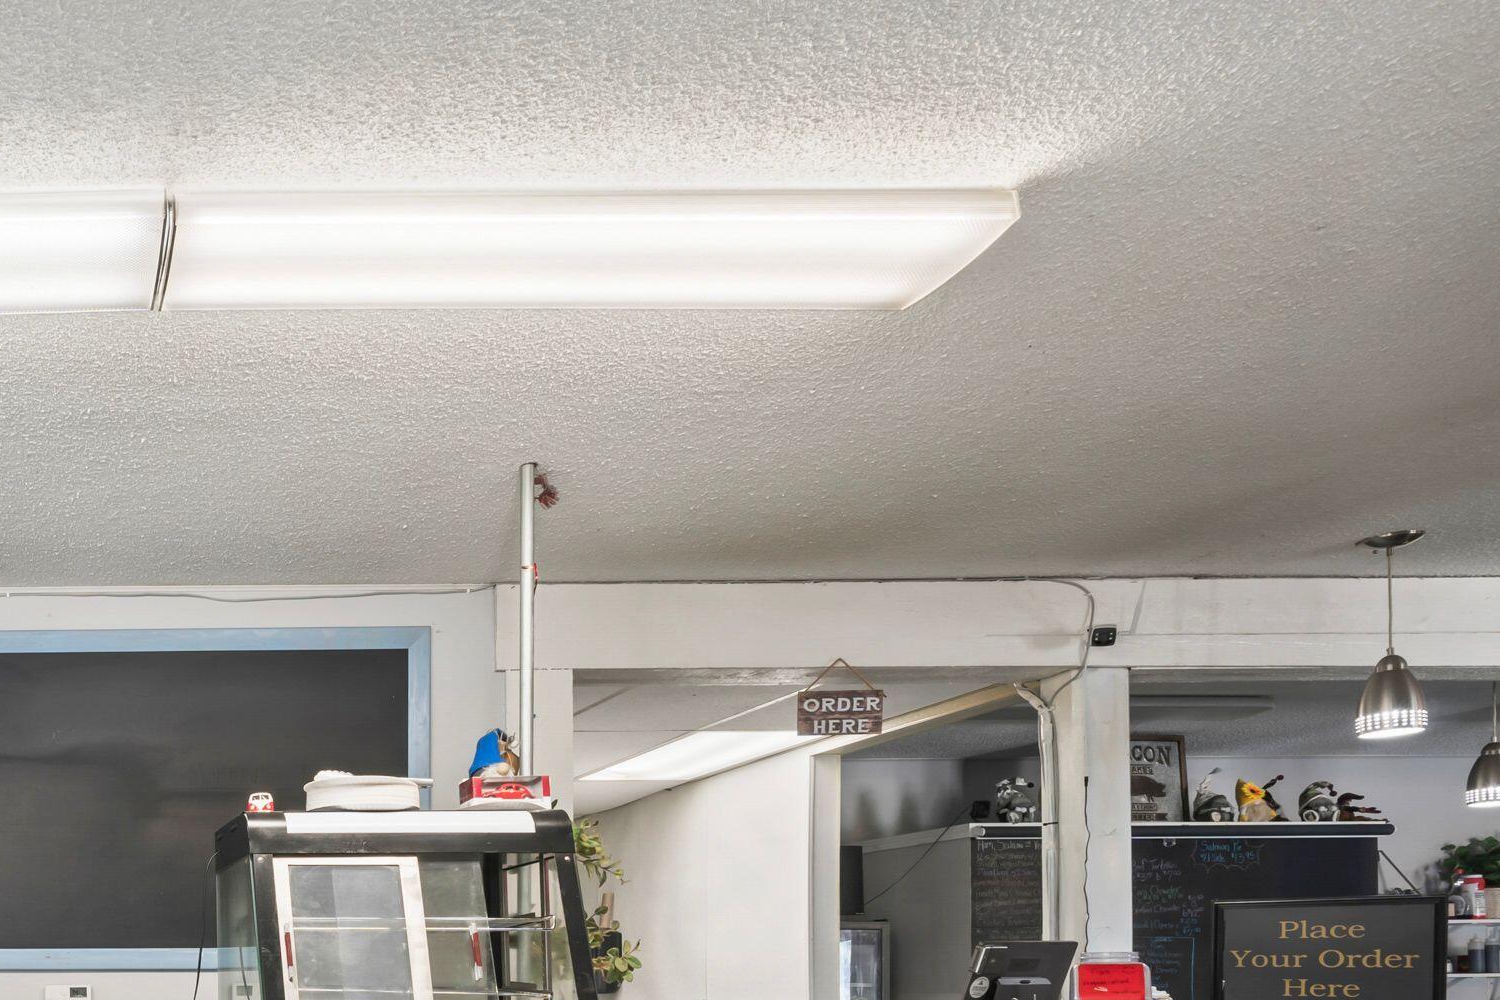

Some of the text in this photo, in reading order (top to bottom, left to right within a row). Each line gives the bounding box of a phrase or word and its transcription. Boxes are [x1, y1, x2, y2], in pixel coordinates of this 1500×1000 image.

[803, 697, 880, 712] ORDER
[813, 719, 870, 734] HERE
[1131, 745, 1172, 767] CON
[1278, 919, 1366, 940] Place
[1230, 949, 1420, 969] Your Order
[1282, 978, 1361, 998] Here
